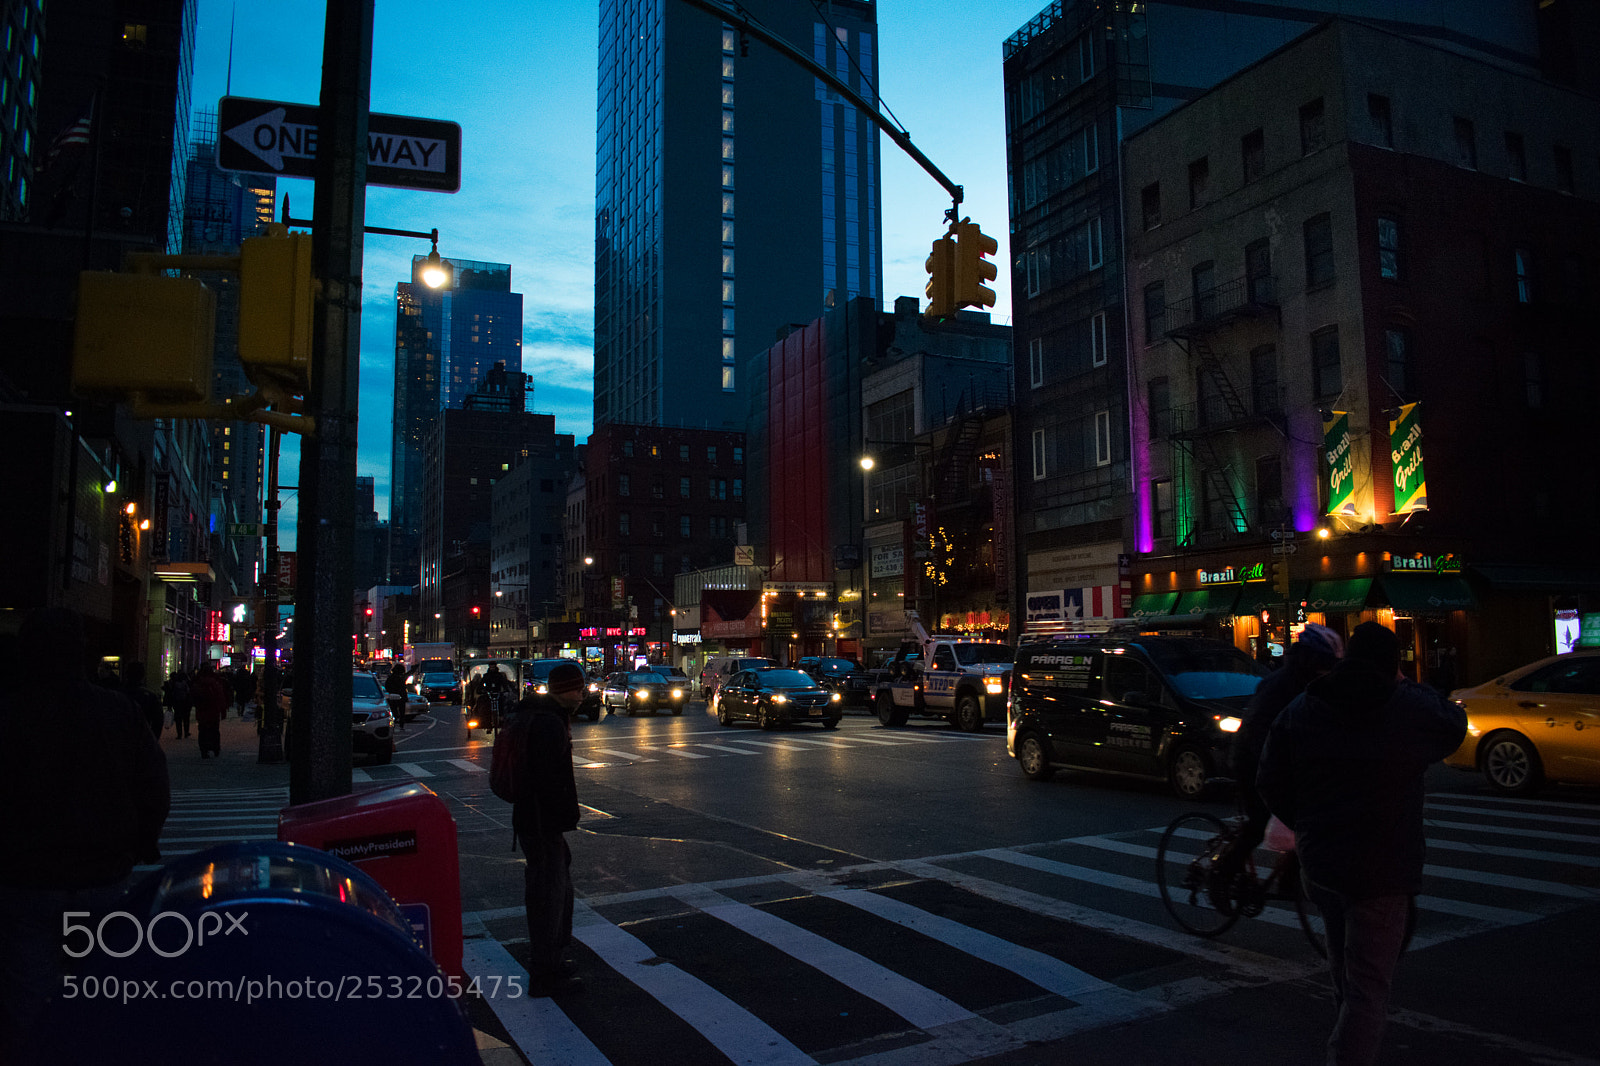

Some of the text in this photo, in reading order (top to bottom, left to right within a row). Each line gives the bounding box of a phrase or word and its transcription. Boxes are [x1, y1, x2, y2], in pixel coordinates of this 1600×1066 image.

[253, 123, 438, 167] ONE WAY
[1326, 431, 1351, 465] Brazil
[1392, 423, 1422, 464] Brazil
[1330, 452, 1353, 495] Grill
[1396, 446, 1424, 492] Grill
[915, 502, 927, 538] ART
[280, 555, 291, 585] ART
[873, 551, 904, 561] FOR SA
[1393, 555, 1432, 569] Brazil
[1200, 563, 1264, 586] Brazil Grill
[606, 628, 622, 636] NYC
[1030, 655, 1093, 665] PARAGON
[929, 678, 948, 691] NYPD
